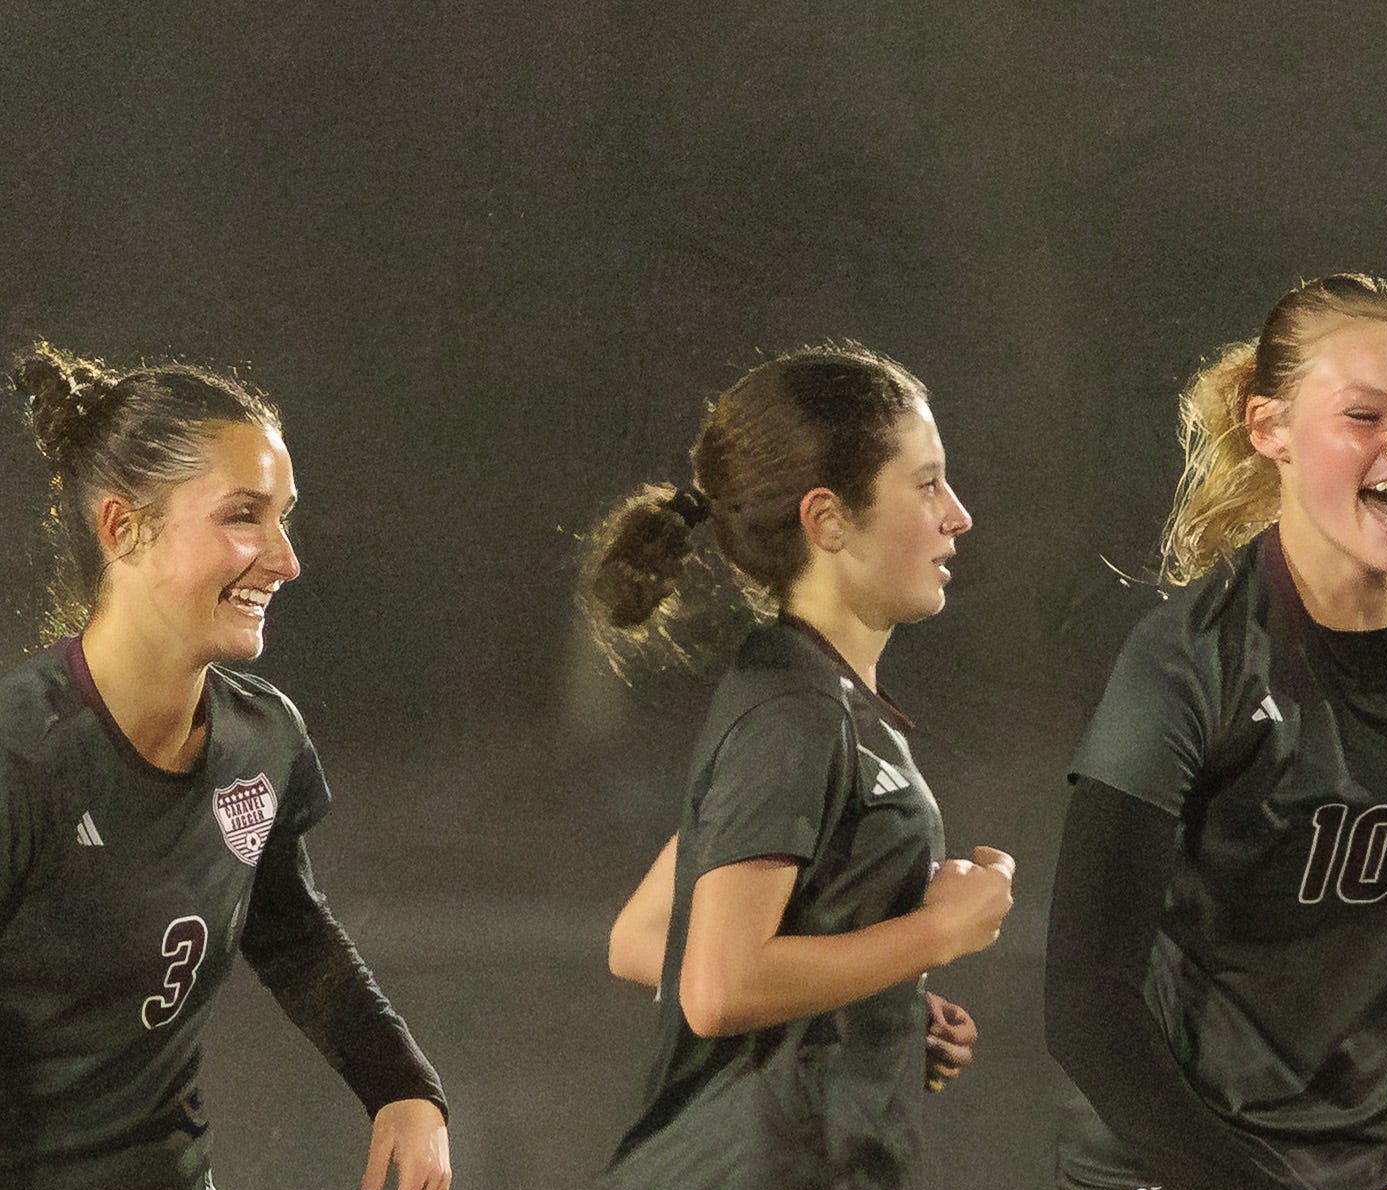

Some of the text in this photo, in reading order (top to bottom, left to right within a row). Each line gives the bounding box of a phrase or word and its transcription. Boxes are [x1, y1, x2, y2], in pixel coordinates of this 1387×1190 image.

[224, 795, 266, 819] CARAVEL
[231, 809, 265, 831] SOCCER
[142, 914, 208, 1029] 3
